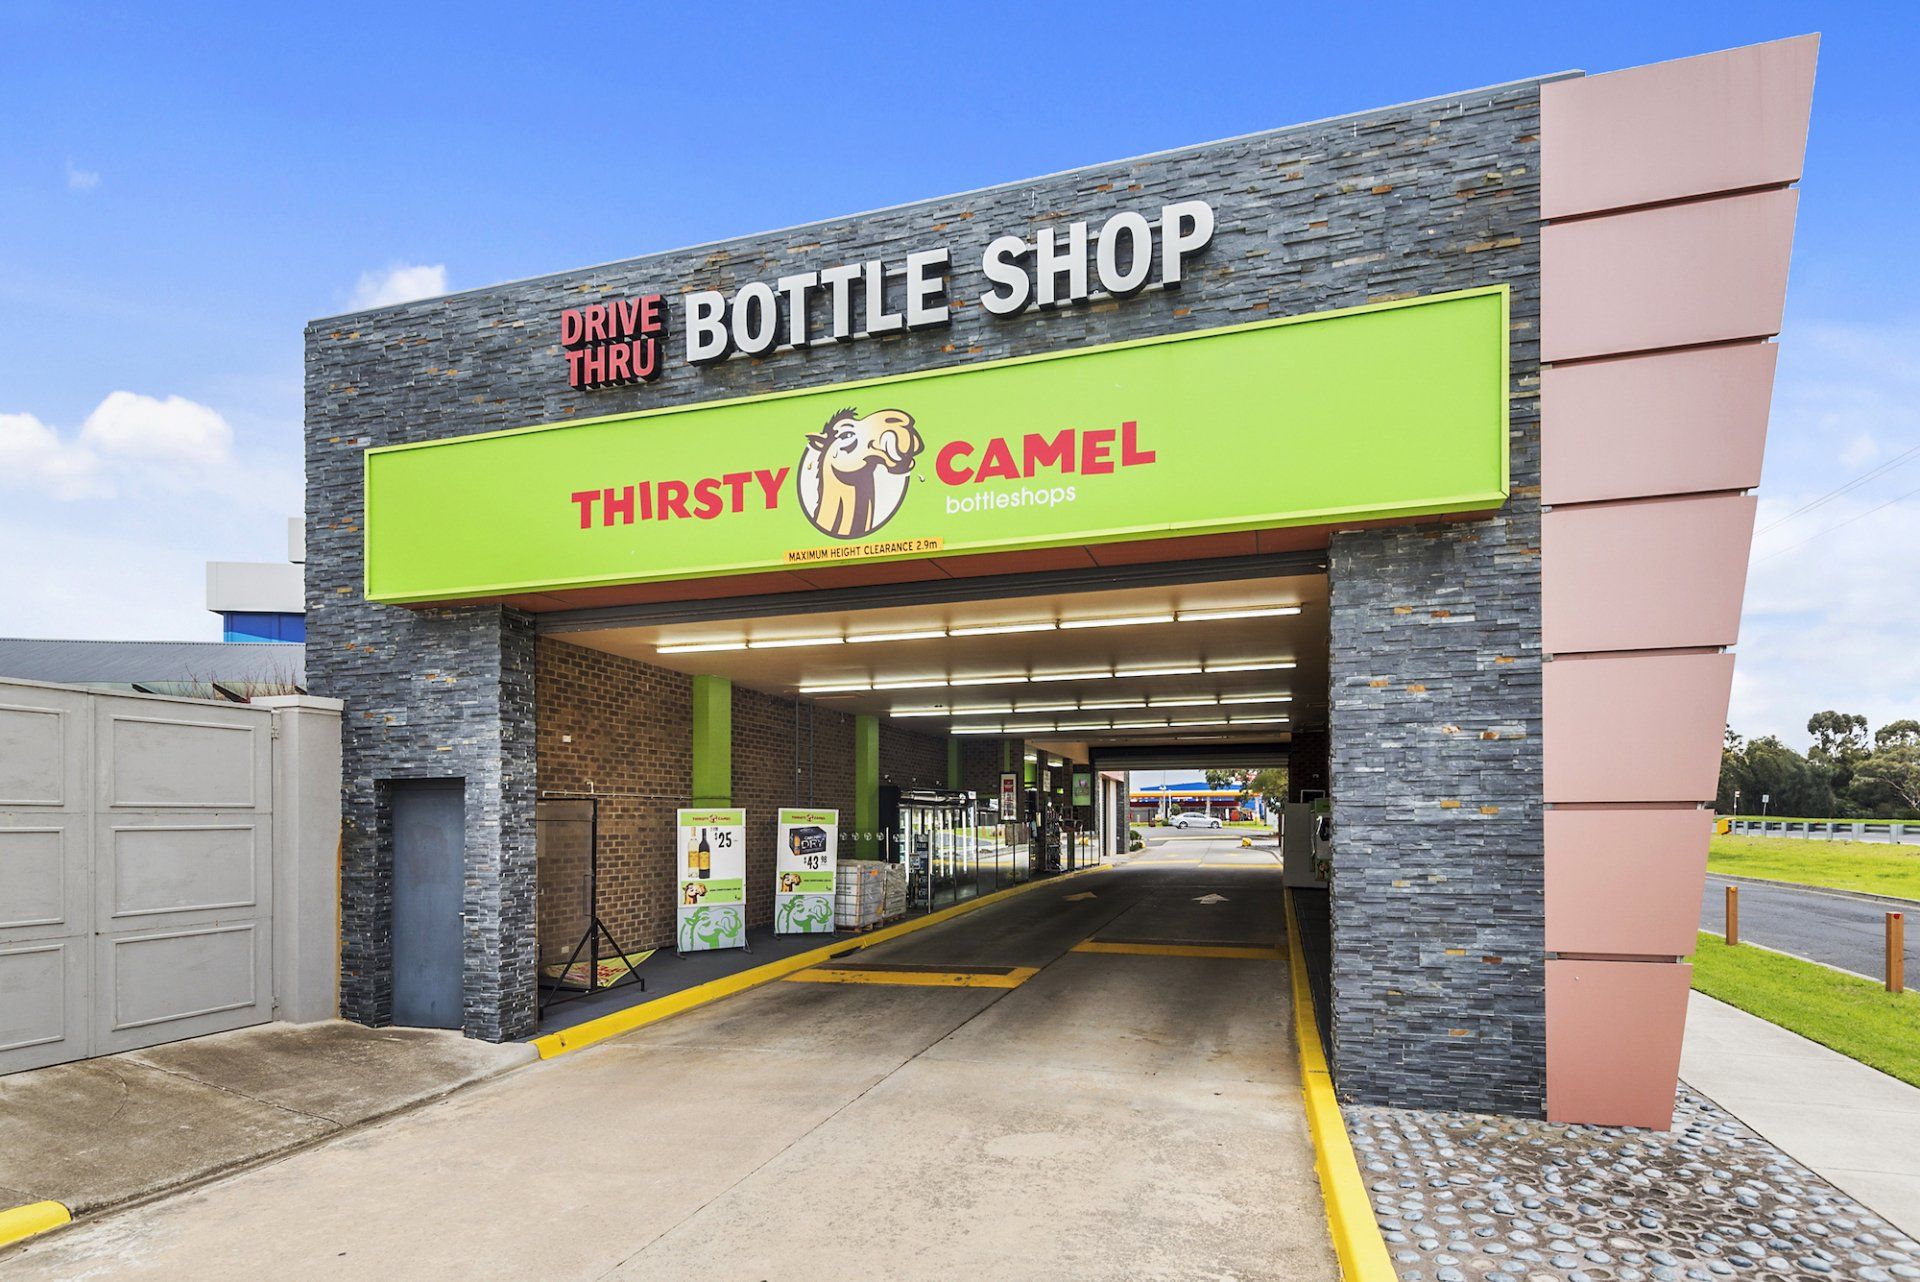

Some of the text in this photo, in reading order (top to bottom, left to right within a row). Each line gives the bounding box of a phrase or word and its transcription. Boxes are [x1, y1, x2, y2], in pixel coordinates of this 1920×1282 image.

[685, 200, 1215, 364] BOTTLE SHOP
[561, 294, 664, 347] DRIVE
[564, 338, 657, 388] THRU
[571, 421, 1155, 529] THIRSTY CAMEL
[946, 486, 1076, 514] bottleshops
[788, 539, 938, 562] MAXIMUM HEIGHT CLEARANCE 2.9m
[801, 838, 824, 850] DRY
